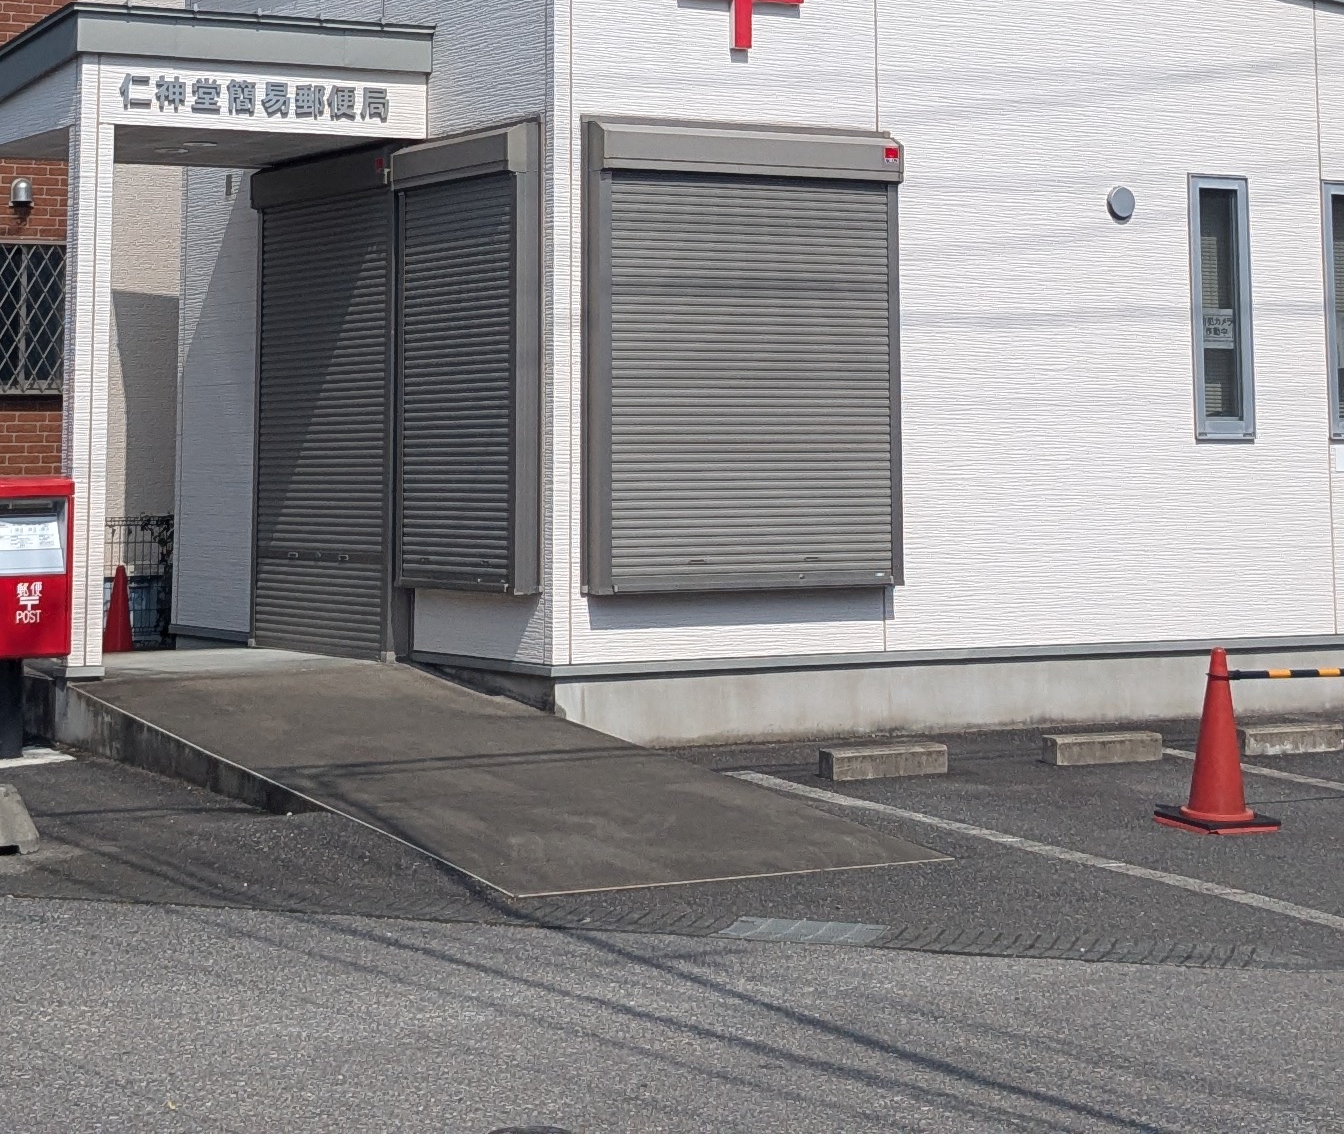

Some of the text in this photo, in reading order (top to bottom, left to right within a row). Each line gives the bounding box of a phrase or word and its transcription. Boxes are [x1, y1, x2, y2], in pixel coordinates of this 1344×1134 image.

[119, 72, 390, 123] 仁神堂簡易郵便局
[16, 581, 43, 598] 郵便
[15, 610, 42, 624] POST
